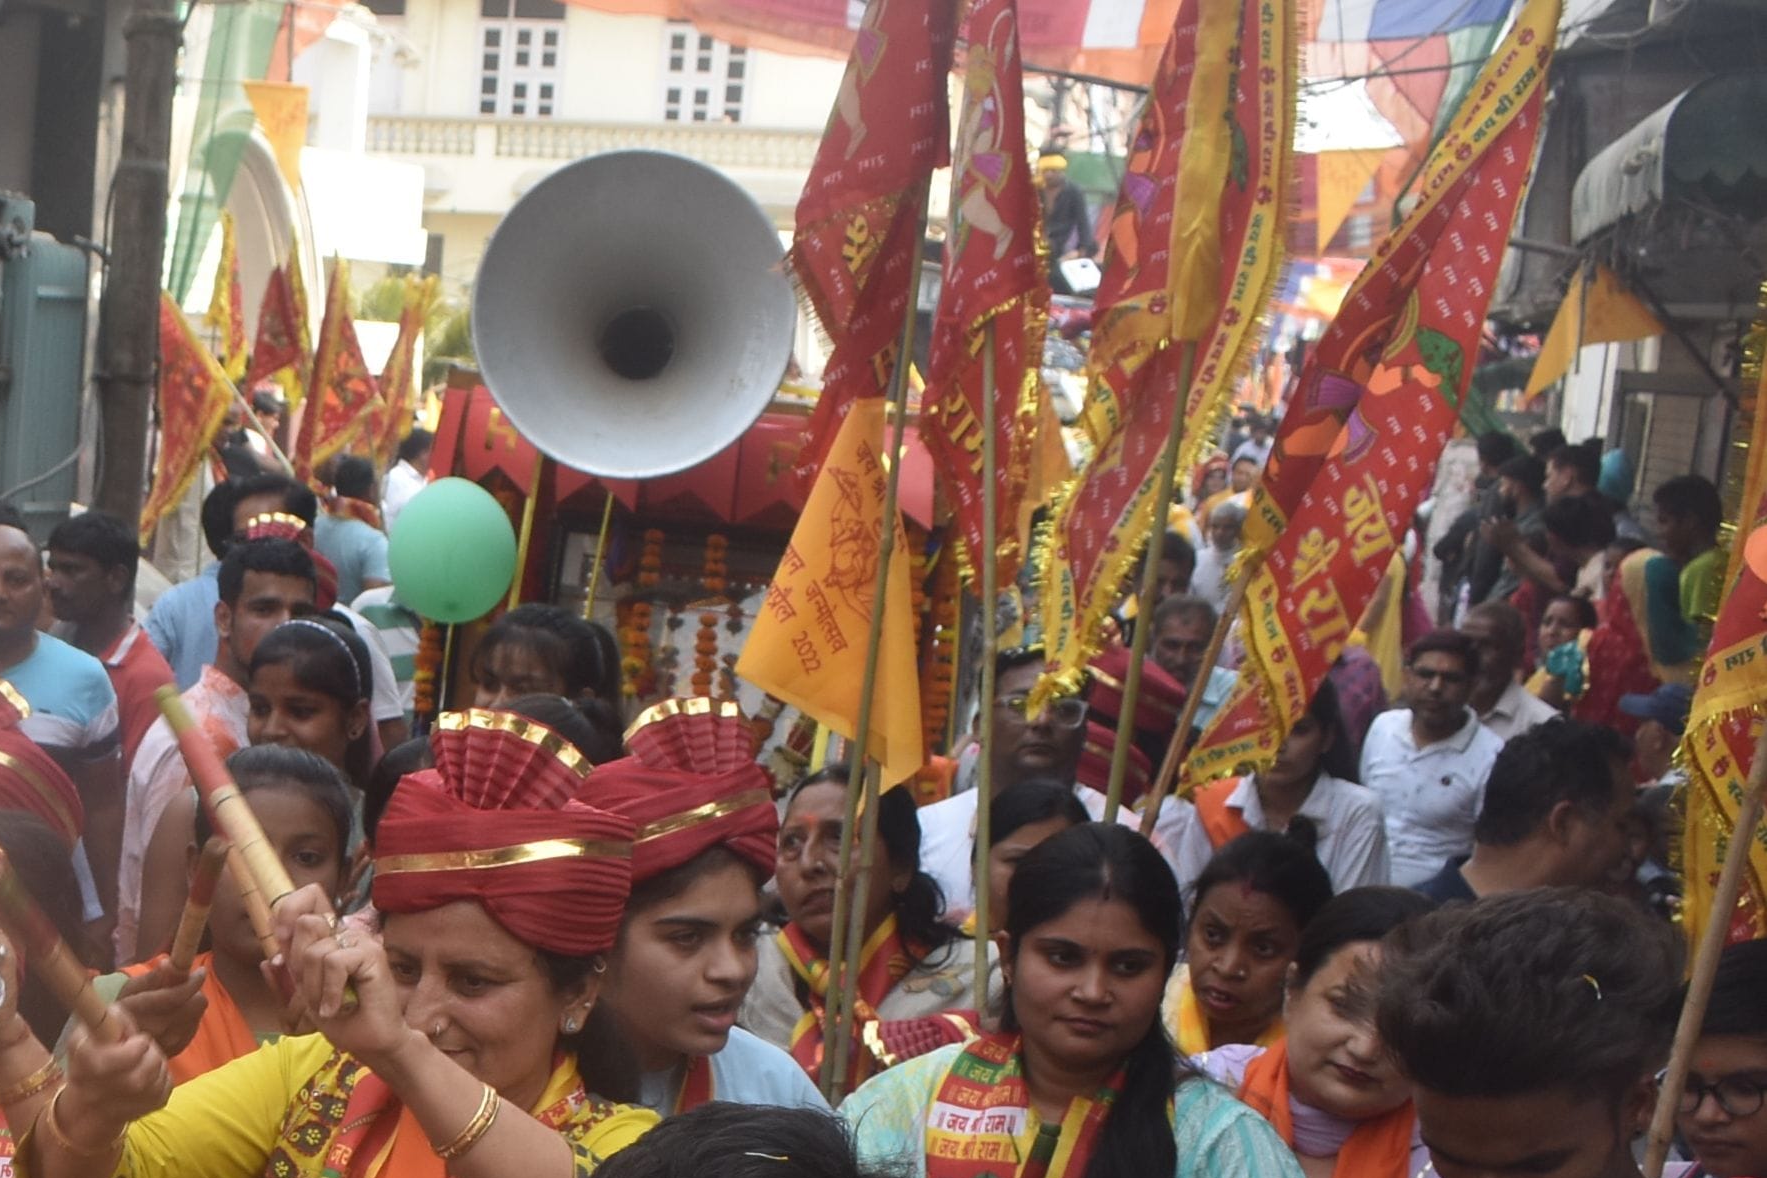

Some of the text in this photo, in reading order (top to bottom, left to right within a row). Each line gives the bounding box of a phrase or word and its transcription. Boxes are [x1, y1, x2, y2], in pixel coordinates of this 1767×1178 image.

[1291, 470, 1397, 664] जय श्री रा
[790, 629, 822, 677] 2022
[946, 1113, 971, 1134] जय
[984, 1114, 1007, 1134] राम
[330, 1143, 353, 1166] जय
[938, 1137, 961, 1157] जय
[978, 1140, 1001, 1160] राम
